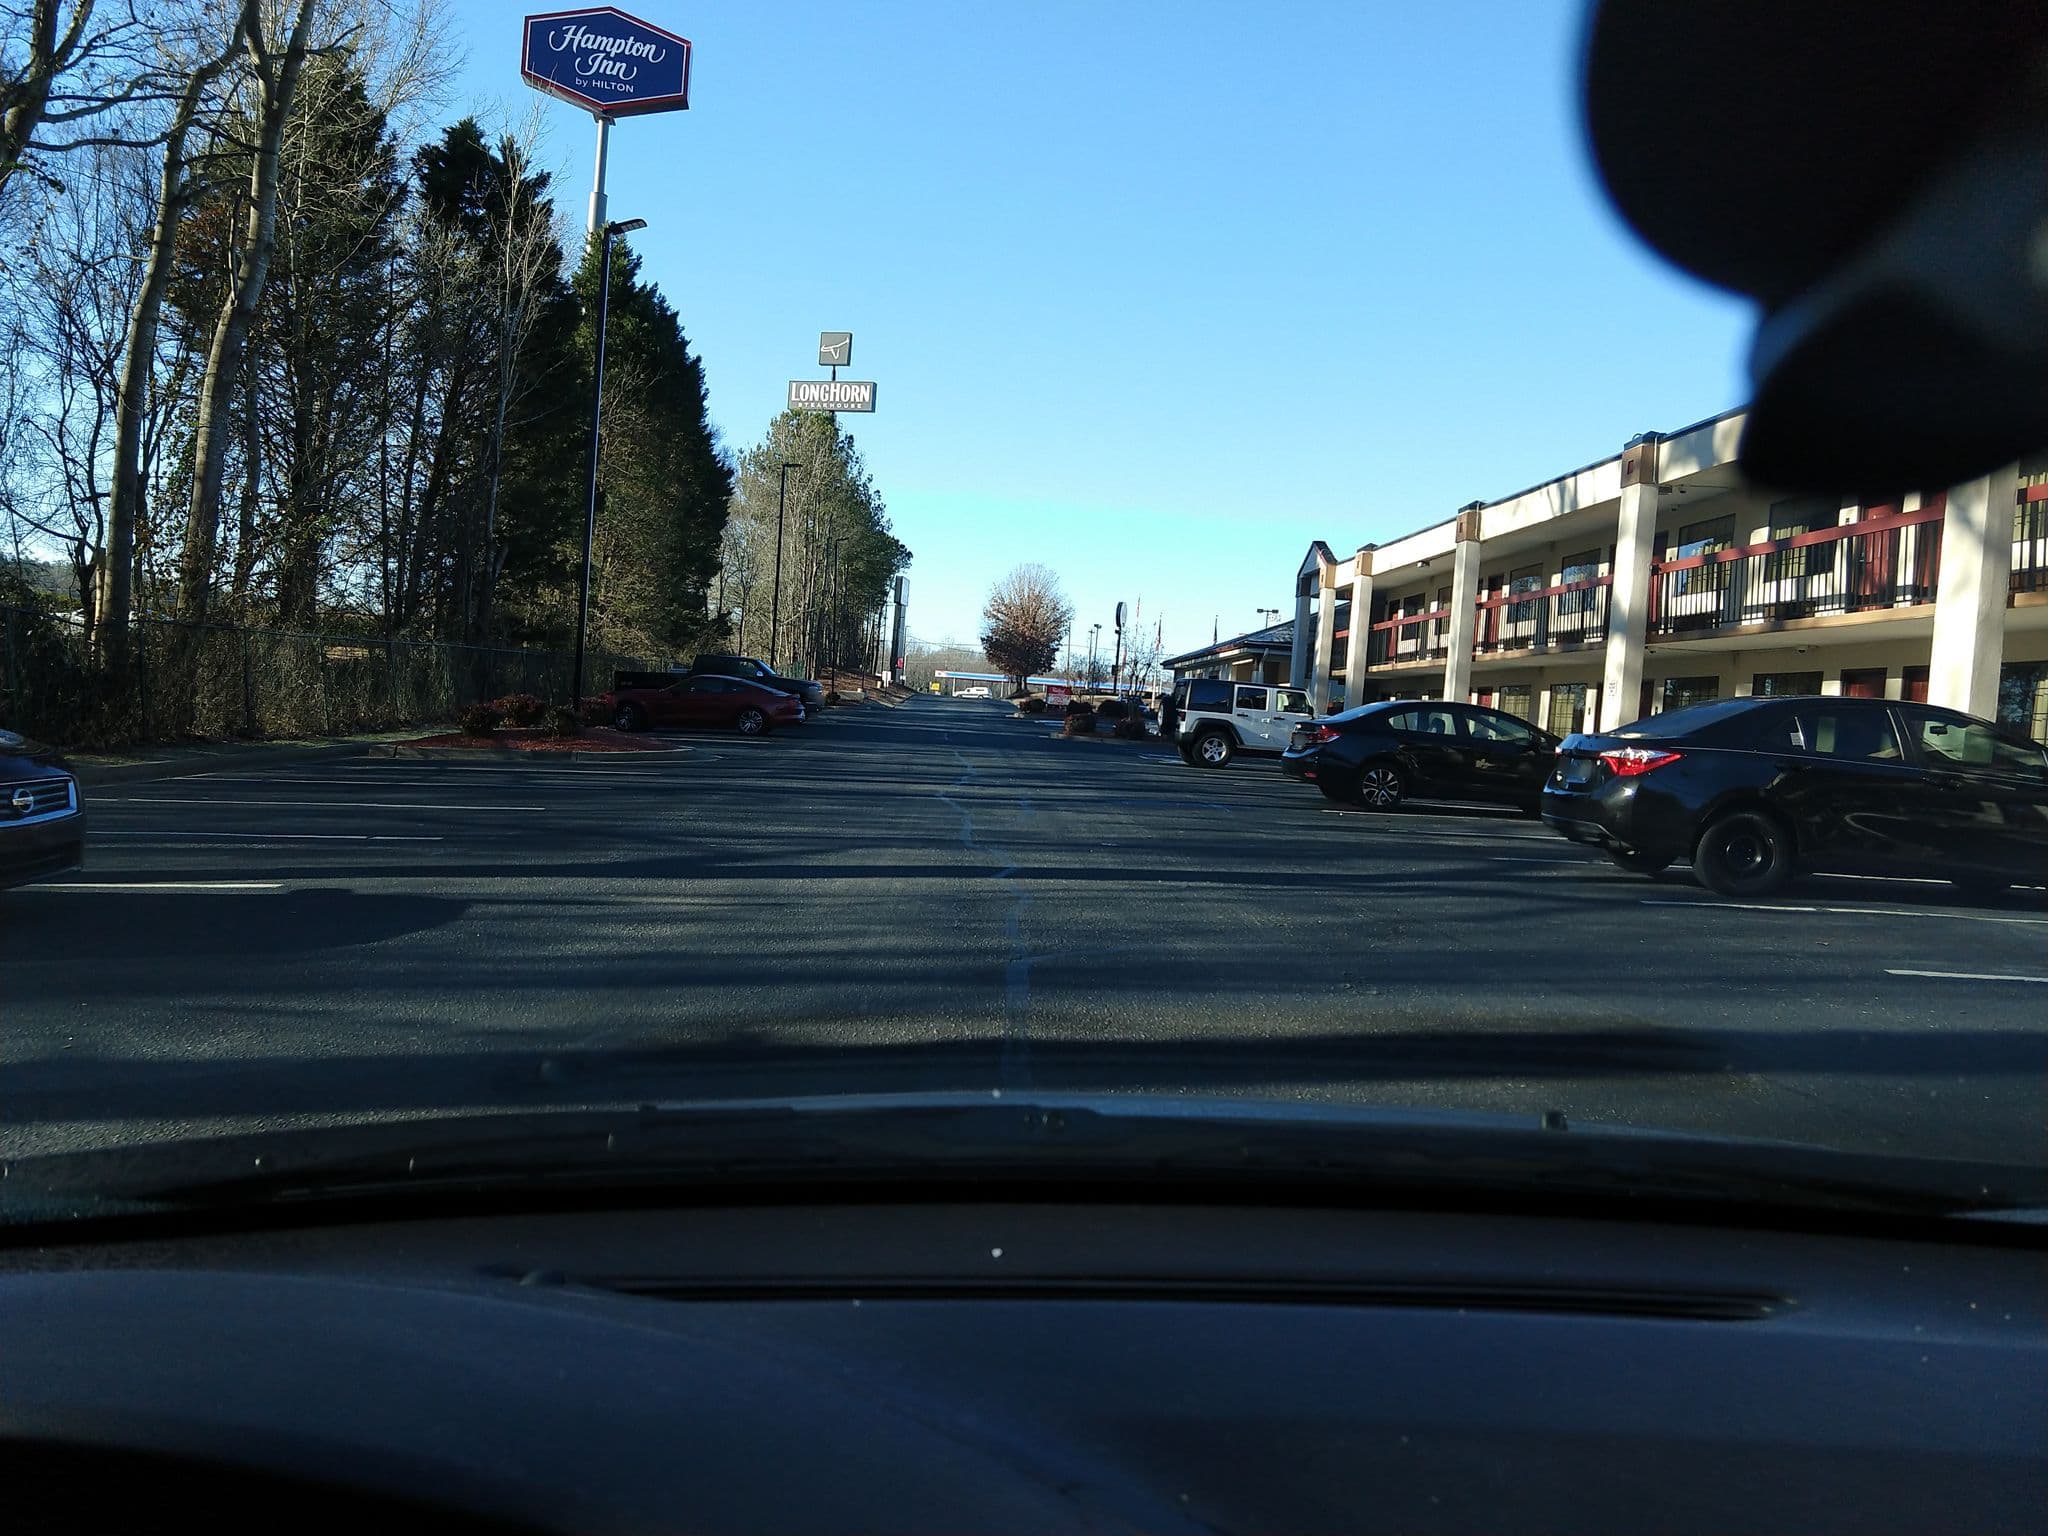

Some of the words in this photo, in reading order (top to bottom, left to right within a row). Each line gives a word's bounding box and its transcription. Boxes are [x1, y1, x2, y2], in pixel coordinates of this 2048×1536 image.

[549, 25, 666, 63] Hampton
[574, 53, 637, 80] Inn
[575, 78, 588, 88] by
[592, 79, 634, 93] HILTON
[791, 382, 870, 402] LONGHORN
